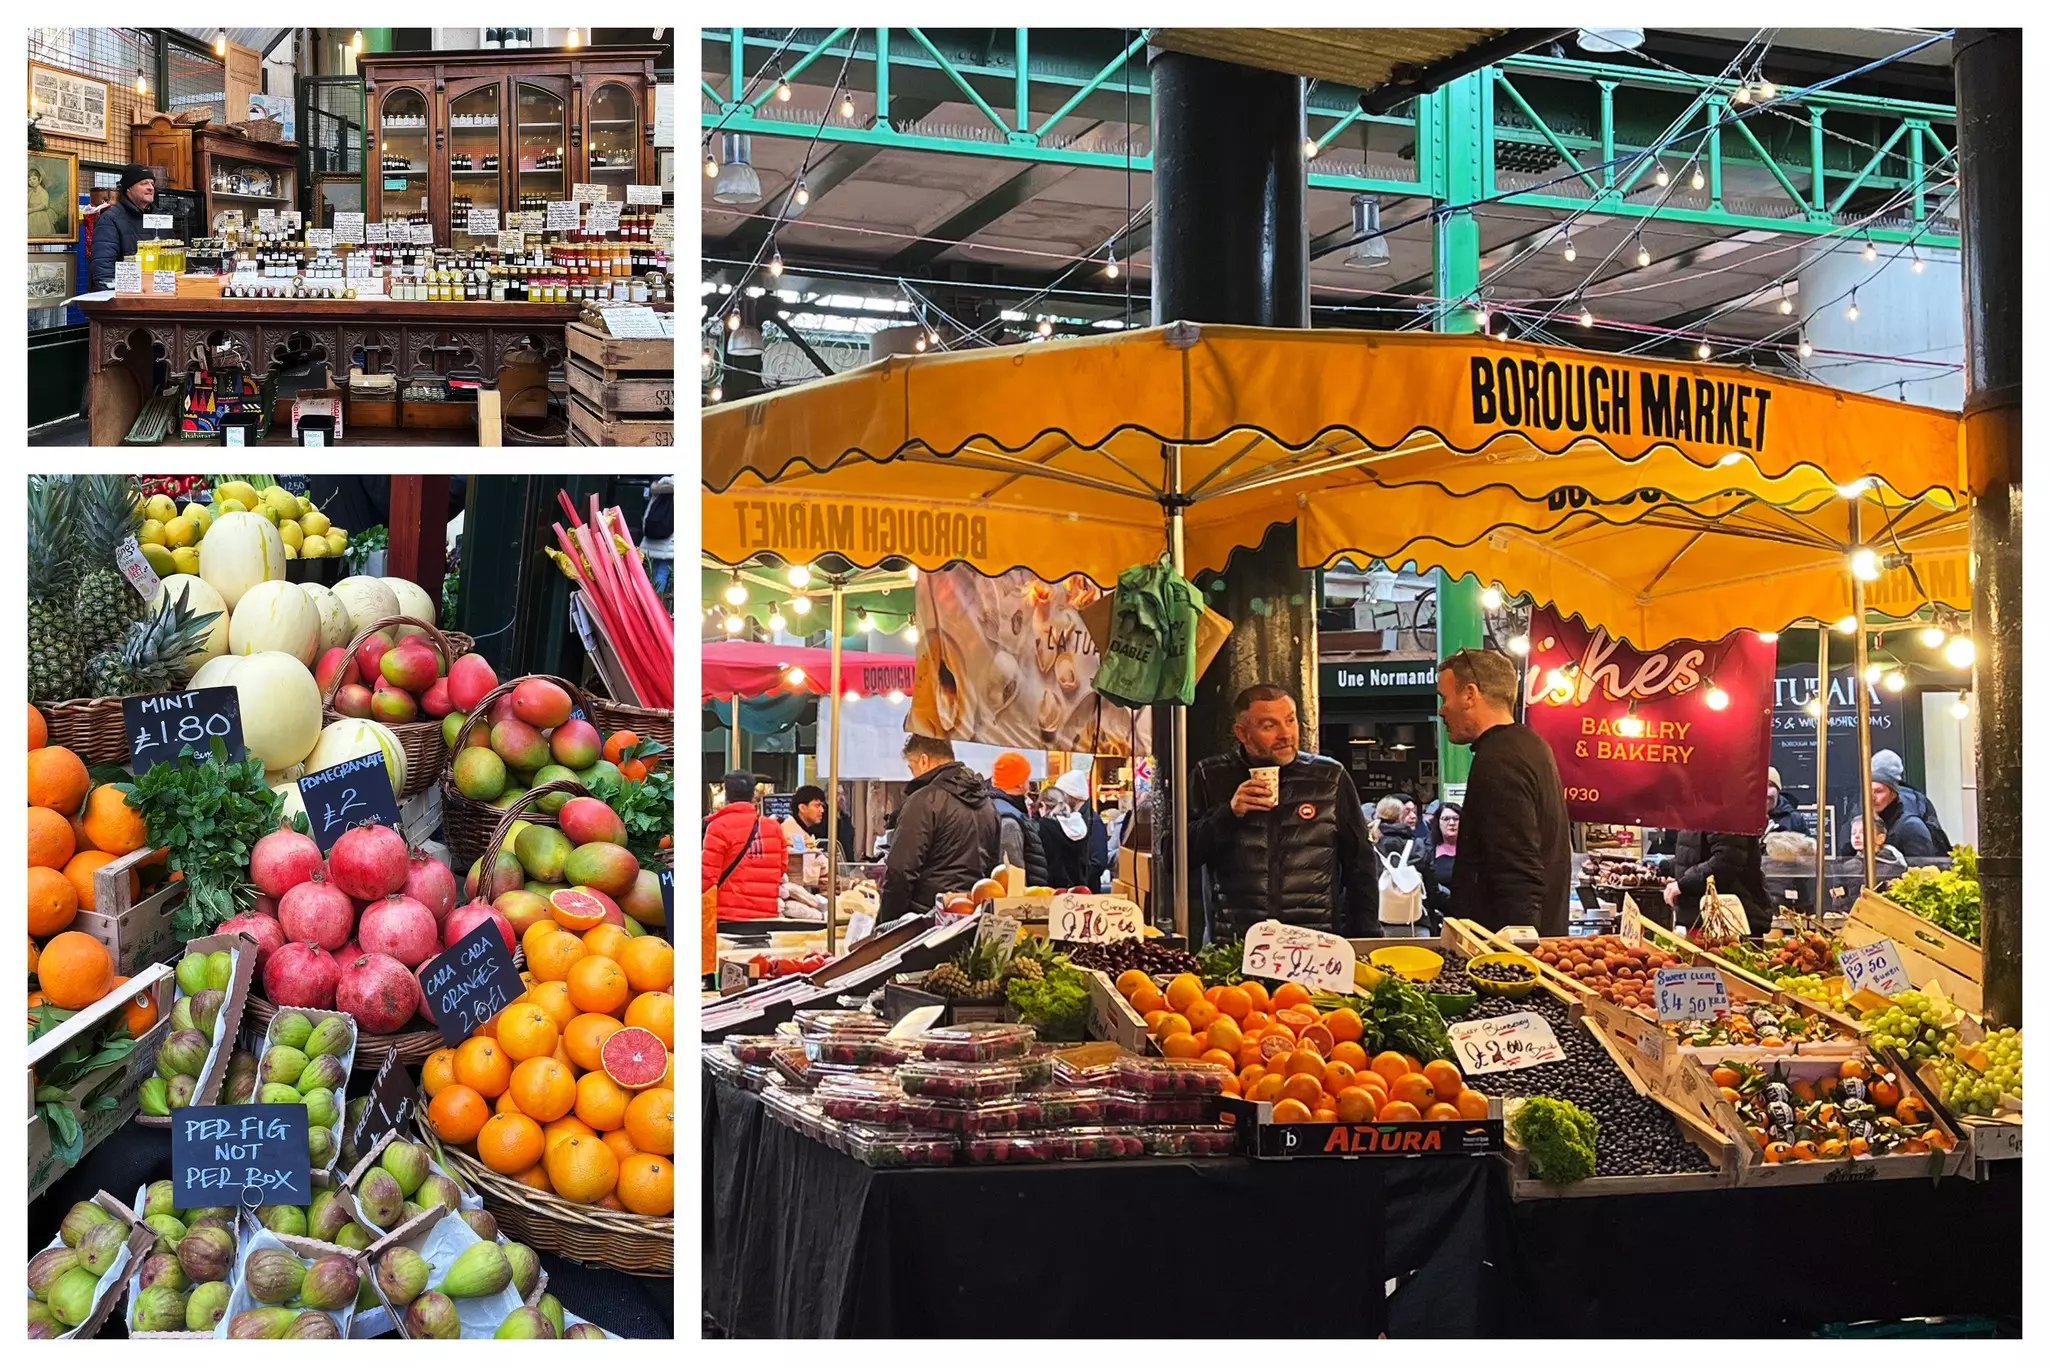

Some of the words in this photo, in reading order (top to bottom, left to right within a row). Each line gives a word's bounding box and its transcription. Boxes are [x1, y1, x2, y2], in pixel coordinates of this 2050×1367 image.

[1470, 356, 1631, 435] BOROUGH
[1640, 372, 1772, 452] MARKET
[863, 666, 912, 690] BOROUGH
[1338, 670, 1365, 687] Une
[141, 692, 200, 714] MINT
[134, 713, 231, 756] £1.80
[1575, 740, 1589, 758] &
[1597, 741, 1694, 764] BAKERY
[300, 752, 385, 793] POMEGRANATE
[1563, 787, 1600, 802] 1930
[427, 964, 457, 996] CARA
[460, 936, 493, 966] CARA
[1249, 944, 1271, 970] 5
[442, 957, 500, 1014] ORANGES
[459, 1010, 475, 1034] 2
[185, 1119, 238, 1142] PER
[240, 1116, 292, 1141] FIG
[1324, 1126, 1442, 1153] ALTURA
[215, 1143, 264, 1161] NOT
[185, 1167, 243, 1190] PER
